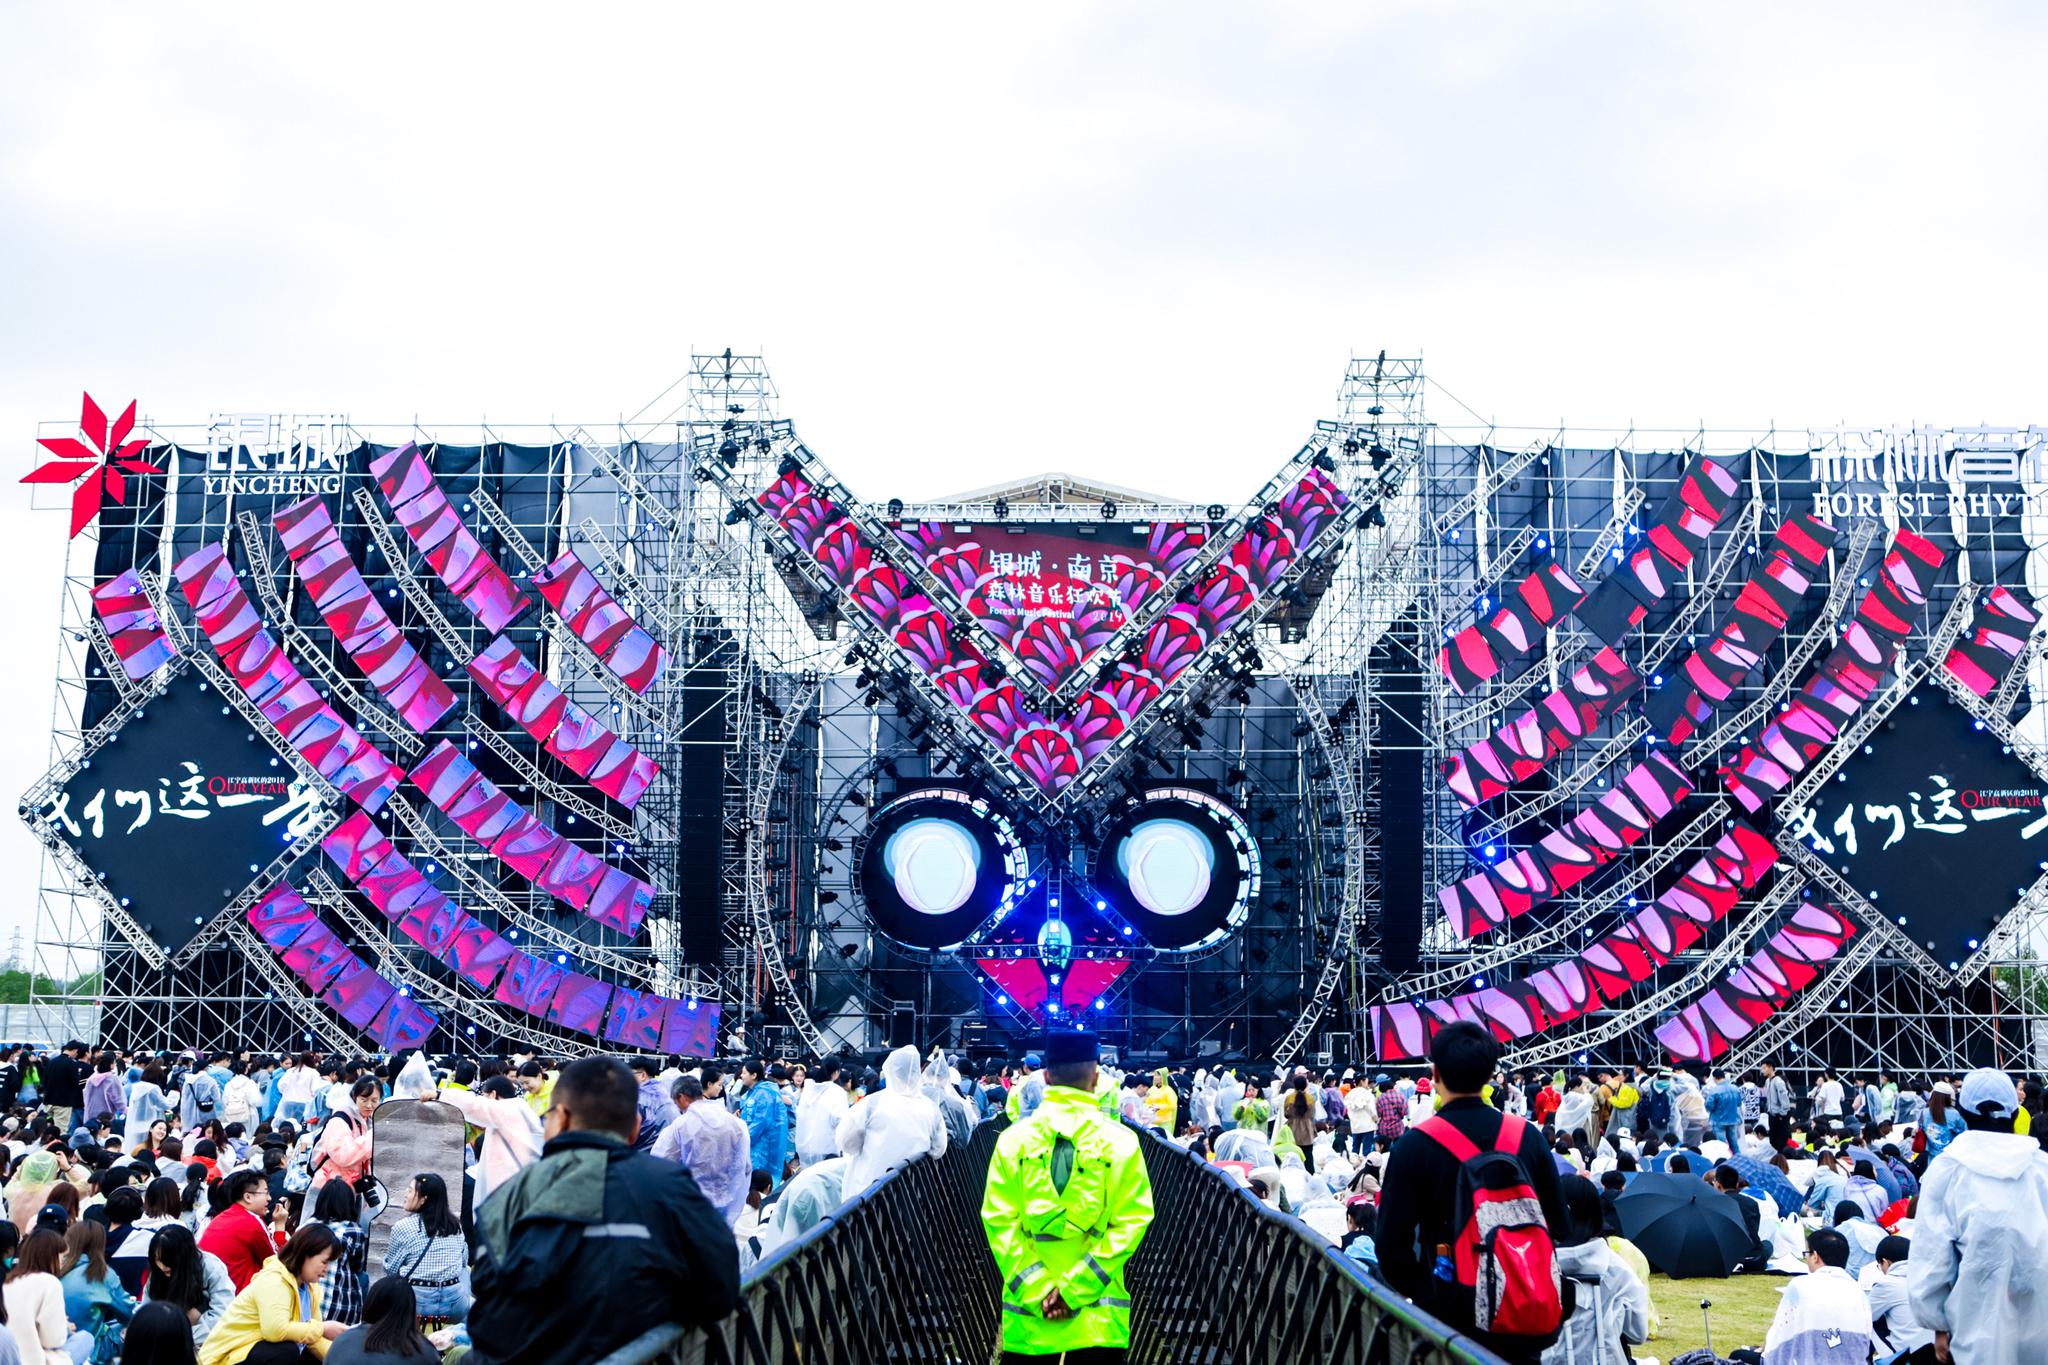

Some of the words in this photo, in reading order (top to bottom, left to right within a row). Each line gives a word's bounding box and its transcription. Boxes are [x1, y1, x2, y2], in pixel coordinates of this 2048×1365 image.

[208, 412, 348, 472] 银城
[203, 475, 341, 495] YINCHENG
[1812, 492, 1935, 517] FOREST
[987, 579, 1122, 608] 森林音乐狂欢节
[989, 606, 1018, 616] Forest
[1018, 608, 1041, 618] Music
[1041, 609, 1075, 620] Festival
[1093, 609, 1122, 622] 2019
[208, 776, 247, 795] OUR
[251, 783, 287, 794] YEAR
[1960, 790, 2000, 809] OUR
[2005, 796, 2041, 807] YEAR
